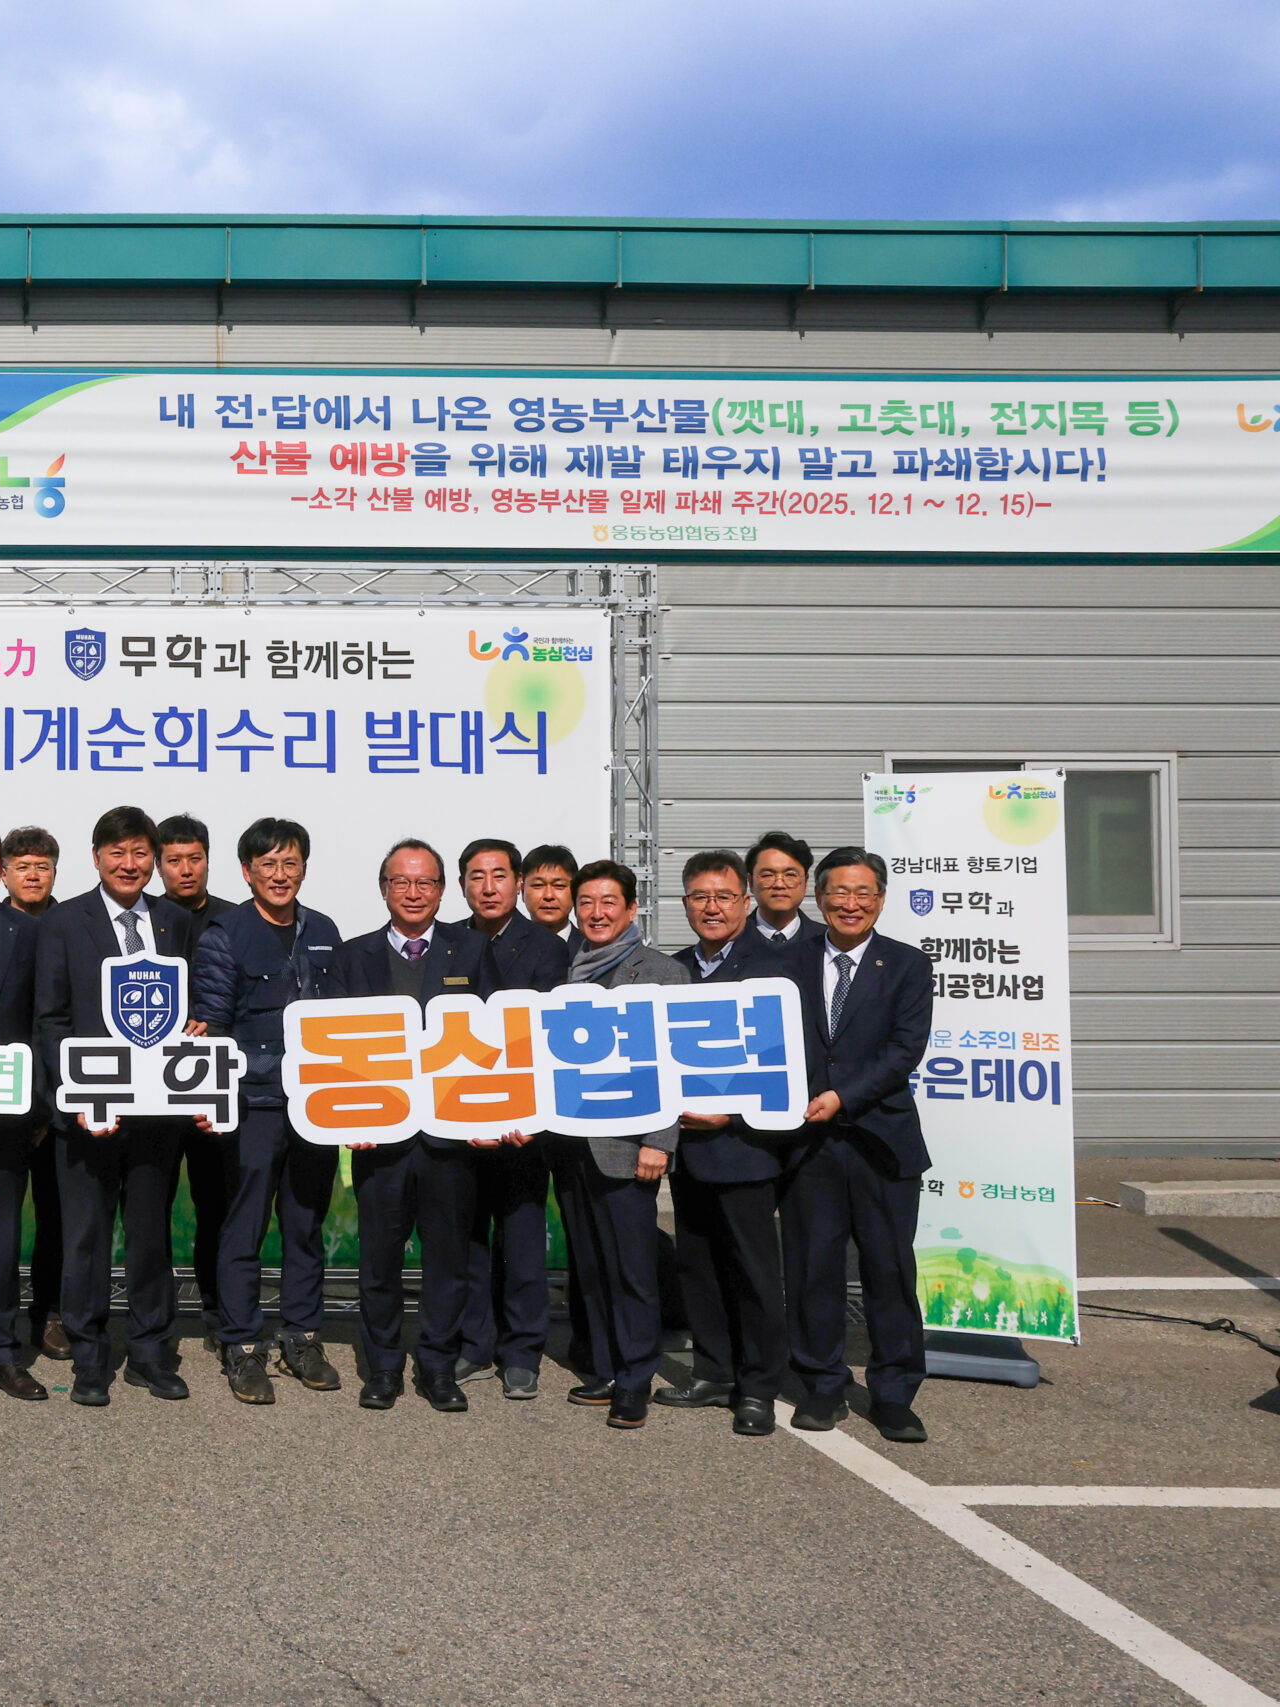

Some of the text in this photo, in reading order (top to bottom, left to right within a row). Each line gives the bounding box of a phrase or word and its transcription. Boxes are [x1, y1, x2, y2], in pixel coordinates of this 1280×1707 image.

[160, 394, 194, 429] 내
[215, 394, 391, 431] 전·답에서
[413, 397, 491, 431] 나온
[838, 400, 970, 438] 고춧대,
[991, 401, 1108, 436] 전지목
[1126, 399, 1179, 437] 등)
[230, 441, 1106, 482] 산불 예방을 위해 제발 태우지 말고 파쇄합시다!
[367, 487, 414, 511] 산불
[425, 488, 478, 513] 예방,
[491, 488, 609, 513] 영농부산물
[620, 490, 665, 514] 일제
[675, 490, 721, 514] 파쇄
[732, 490, 855, 516] 주간(2025.
[868, 493, 911, 515] 12.1
[956, 493, 987, 516] 12.
[611, 525, 757, 541] 웅동농업협동조합
[266, 640, 414, 680] 함께하는
[533, 643, 592, 661] 농심천심
[366, 710, 547, 774] 발대식
[891, 857, 1037, 874] 경남대표 향토기업
[920, 937, 1020, 964] 함께하는
[129, 971, 161, 981] MUHAK
[959, 1030, 1015, 1049] 소주의
[1022, 1032, 1060, 1051] 원조
[299, 995, 790, 1128] 동심협력
[65, 1042, 239, 1124] 무학
[981, 1184, 1054, 1202] 경남농협
